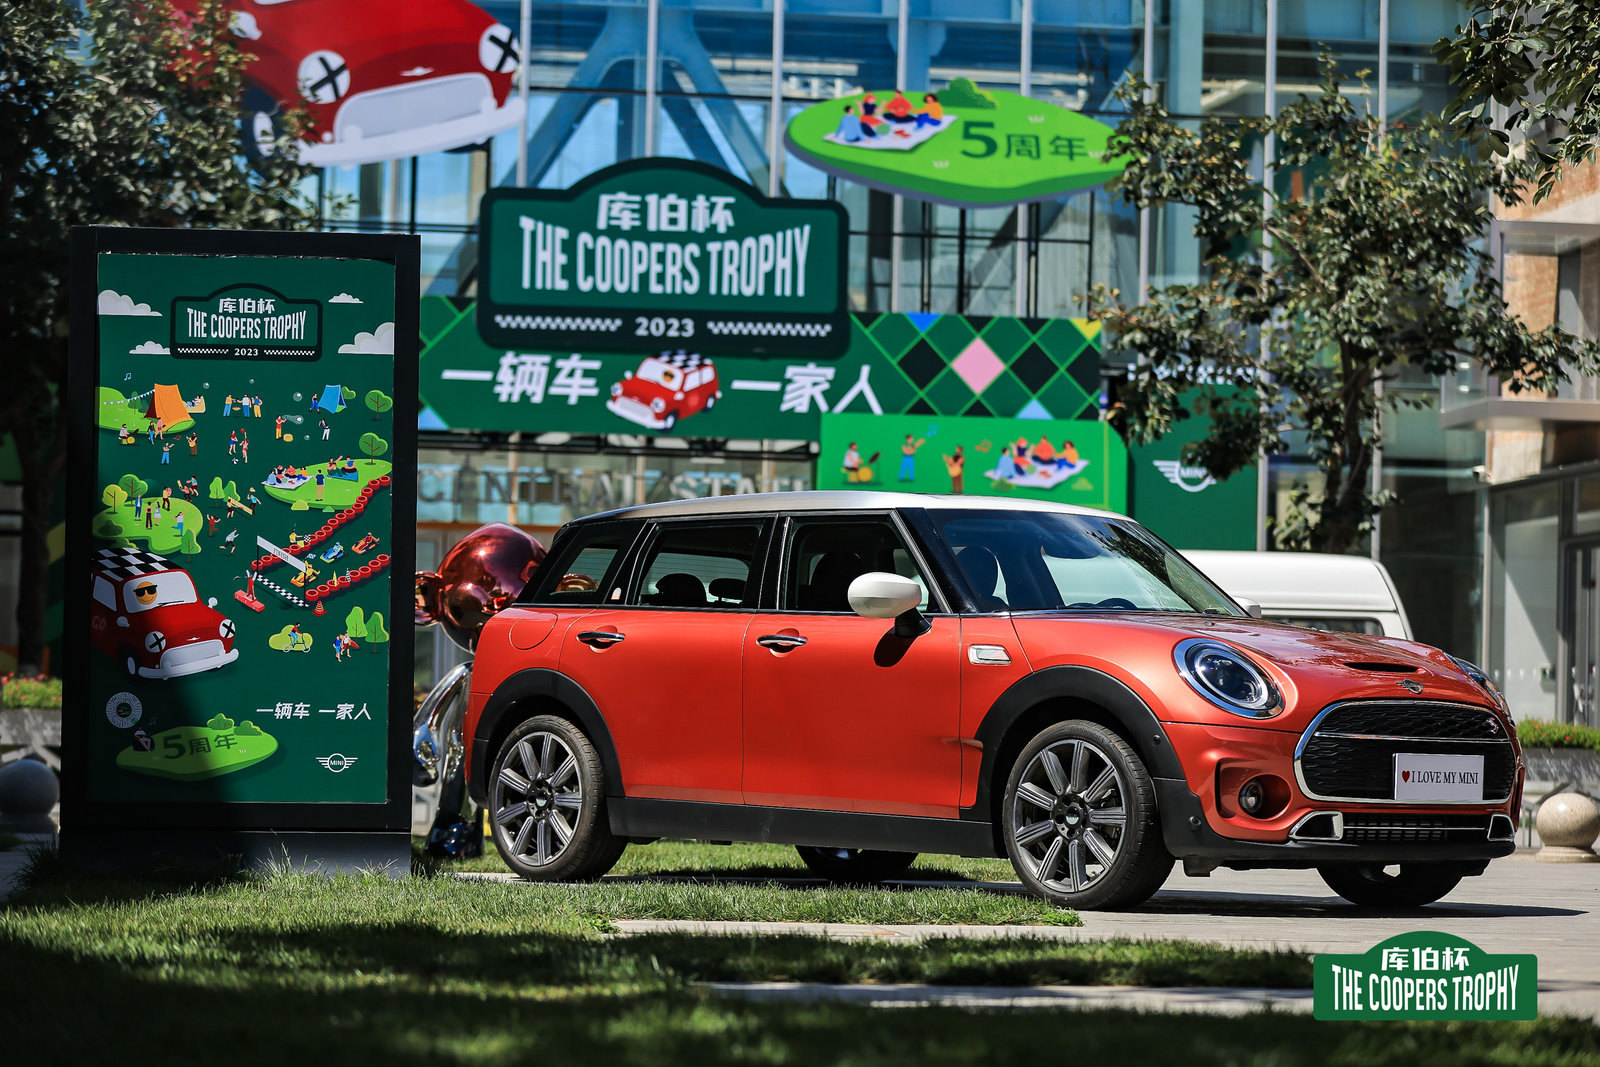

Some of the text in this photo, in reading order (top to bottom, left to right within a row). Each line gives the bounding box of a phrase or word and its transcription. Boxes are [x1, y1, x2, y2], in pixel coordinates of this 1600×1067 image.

[960, 121, 1089, 162] 5周年
[596, 192, 736, 234] 库伯杯
[519, 216, 812, 298] THE COOPERS TROPHY
[218, 298, 276, 315] 库伯杯
[187, 307, 307, 340] THE COOPERS TROPHY
[634, 317, 696, 338] 2023
[234, 348, 259, 357] 2023
[440, 351, 885, 416] 一辆车 一家人
[256, 702, 372, 720] 一辆车 一家人
[162, 732, 239, 760] 5周年
[1411, 771, 1479, 784] I LOVE MY MINI
